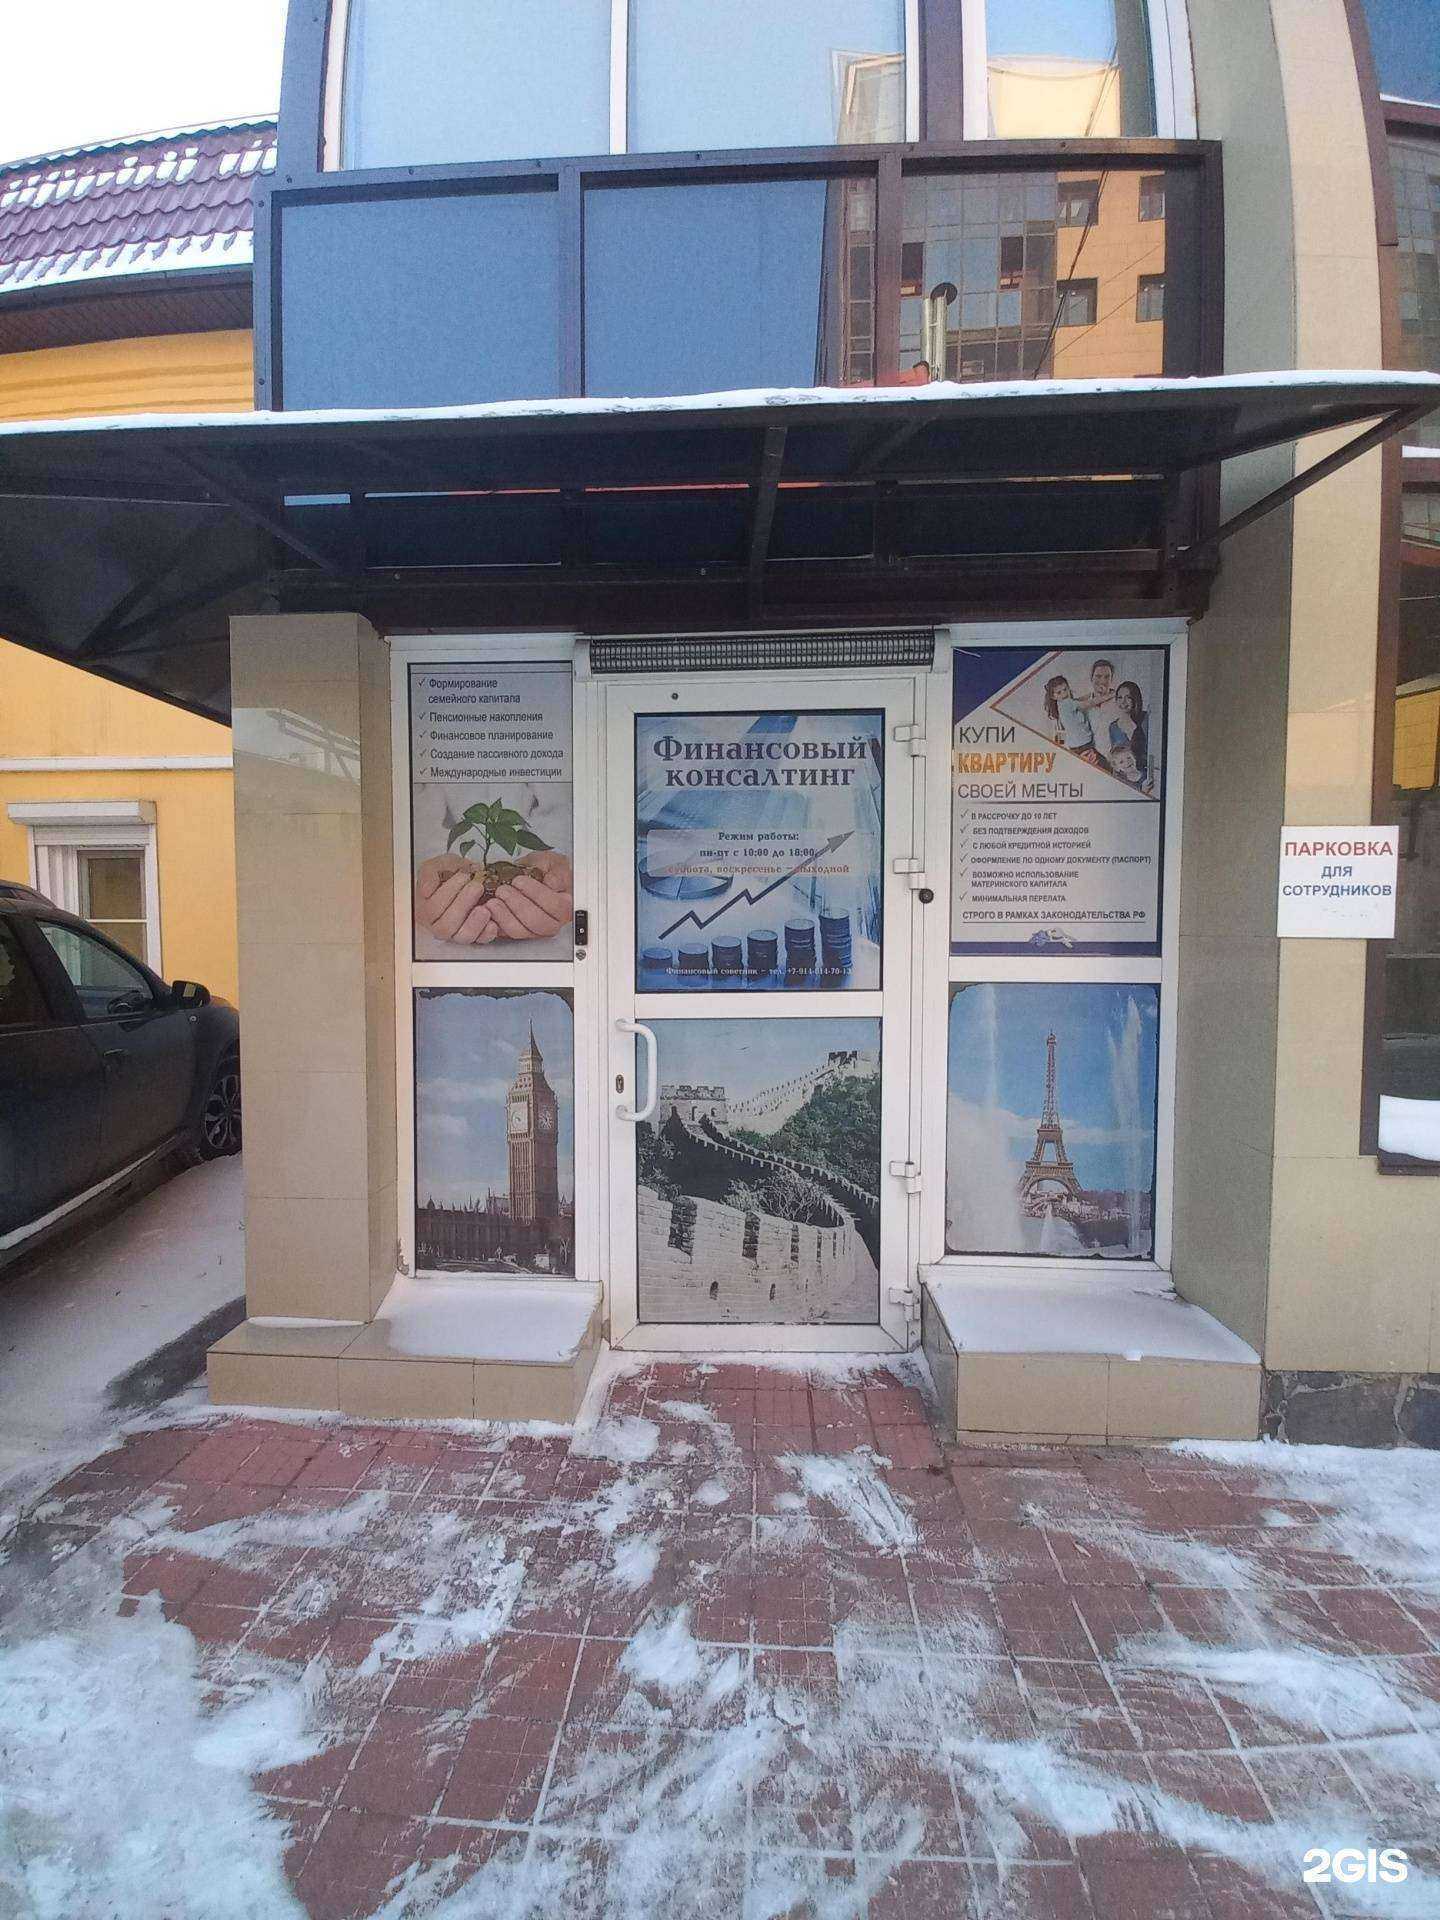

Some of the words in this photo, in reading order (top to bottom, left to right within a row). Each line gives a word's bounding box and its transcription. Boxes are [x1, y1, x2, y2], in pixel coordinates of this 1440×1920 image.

[429, 679, 497, 689] Формирование
[429, 694, 476, 704] семейного
[479, 695, 520, 704] капитала
[429, 712, 486, 721] Пенсионные
[490, 713, 543, 721] накопления
[430, 732, 485, 741] Финансовое
[488, 731, 553, 741] планирование
[960, 727, 1015, 743] КУПИ
[653, 736, 867, 761] Финансовый
[430, 749, 474, 760] Создание
[478, 750, 527, 759] пассивного
[531, 750, 563, 759] дохода
[958, 753, 1056, 773] КВАРТИРУ
[430, 767, 506, 779] Международные
[510, 767, 561, 777] инвестиции
[666, 768, 855, 786] консалтинг
[958, 781, 1016, 798] СВОЕЙ
[1022, 783, 1083, 798] МЕЧТЫ
[1021, 813, 1032, 821] ДО
[989, 827, 1052, 835] ПОДТВЕРЖДЕНИЯ
[1054, 827, 1089, 835] ДОХОДОВ
[718, 832, 753, 841] Режим
[758, 832, 799, 842] работы:
[979, 841, 1006, 849] ЛЮБОЙ
[1008, 841, 1050, 849] КРЕДИТНОЙ
[1053, 841, 1091, 849] ИСТОРИЕЙ
[1285, 842, 1393, 856] ПАРКОВКА
[743, 848, 769, 857] 10:00
[772, 849, 785, 858] до
[1112, 856, 1151, 864] (ПАСПОРТ)
[717, 866, 782, 875] воскресенье
[1321, 866, 1352, 879] ДЛЯ
[972, 880, 1028, 888] МАТЕРИНСКОГО
[1283, 885, 1392, 897] СОТРУДНИКОВ
[963, 911, 995, 919] СТРОГО
[997, 911, 1003, 919] В
[1006, 911, 1038, 919] РАМКАХ
[1041, 911, 1131, 919] ЗАКОНОДАТЕЛЬСТВА
[1133, 911, 1146, 919] РФ
